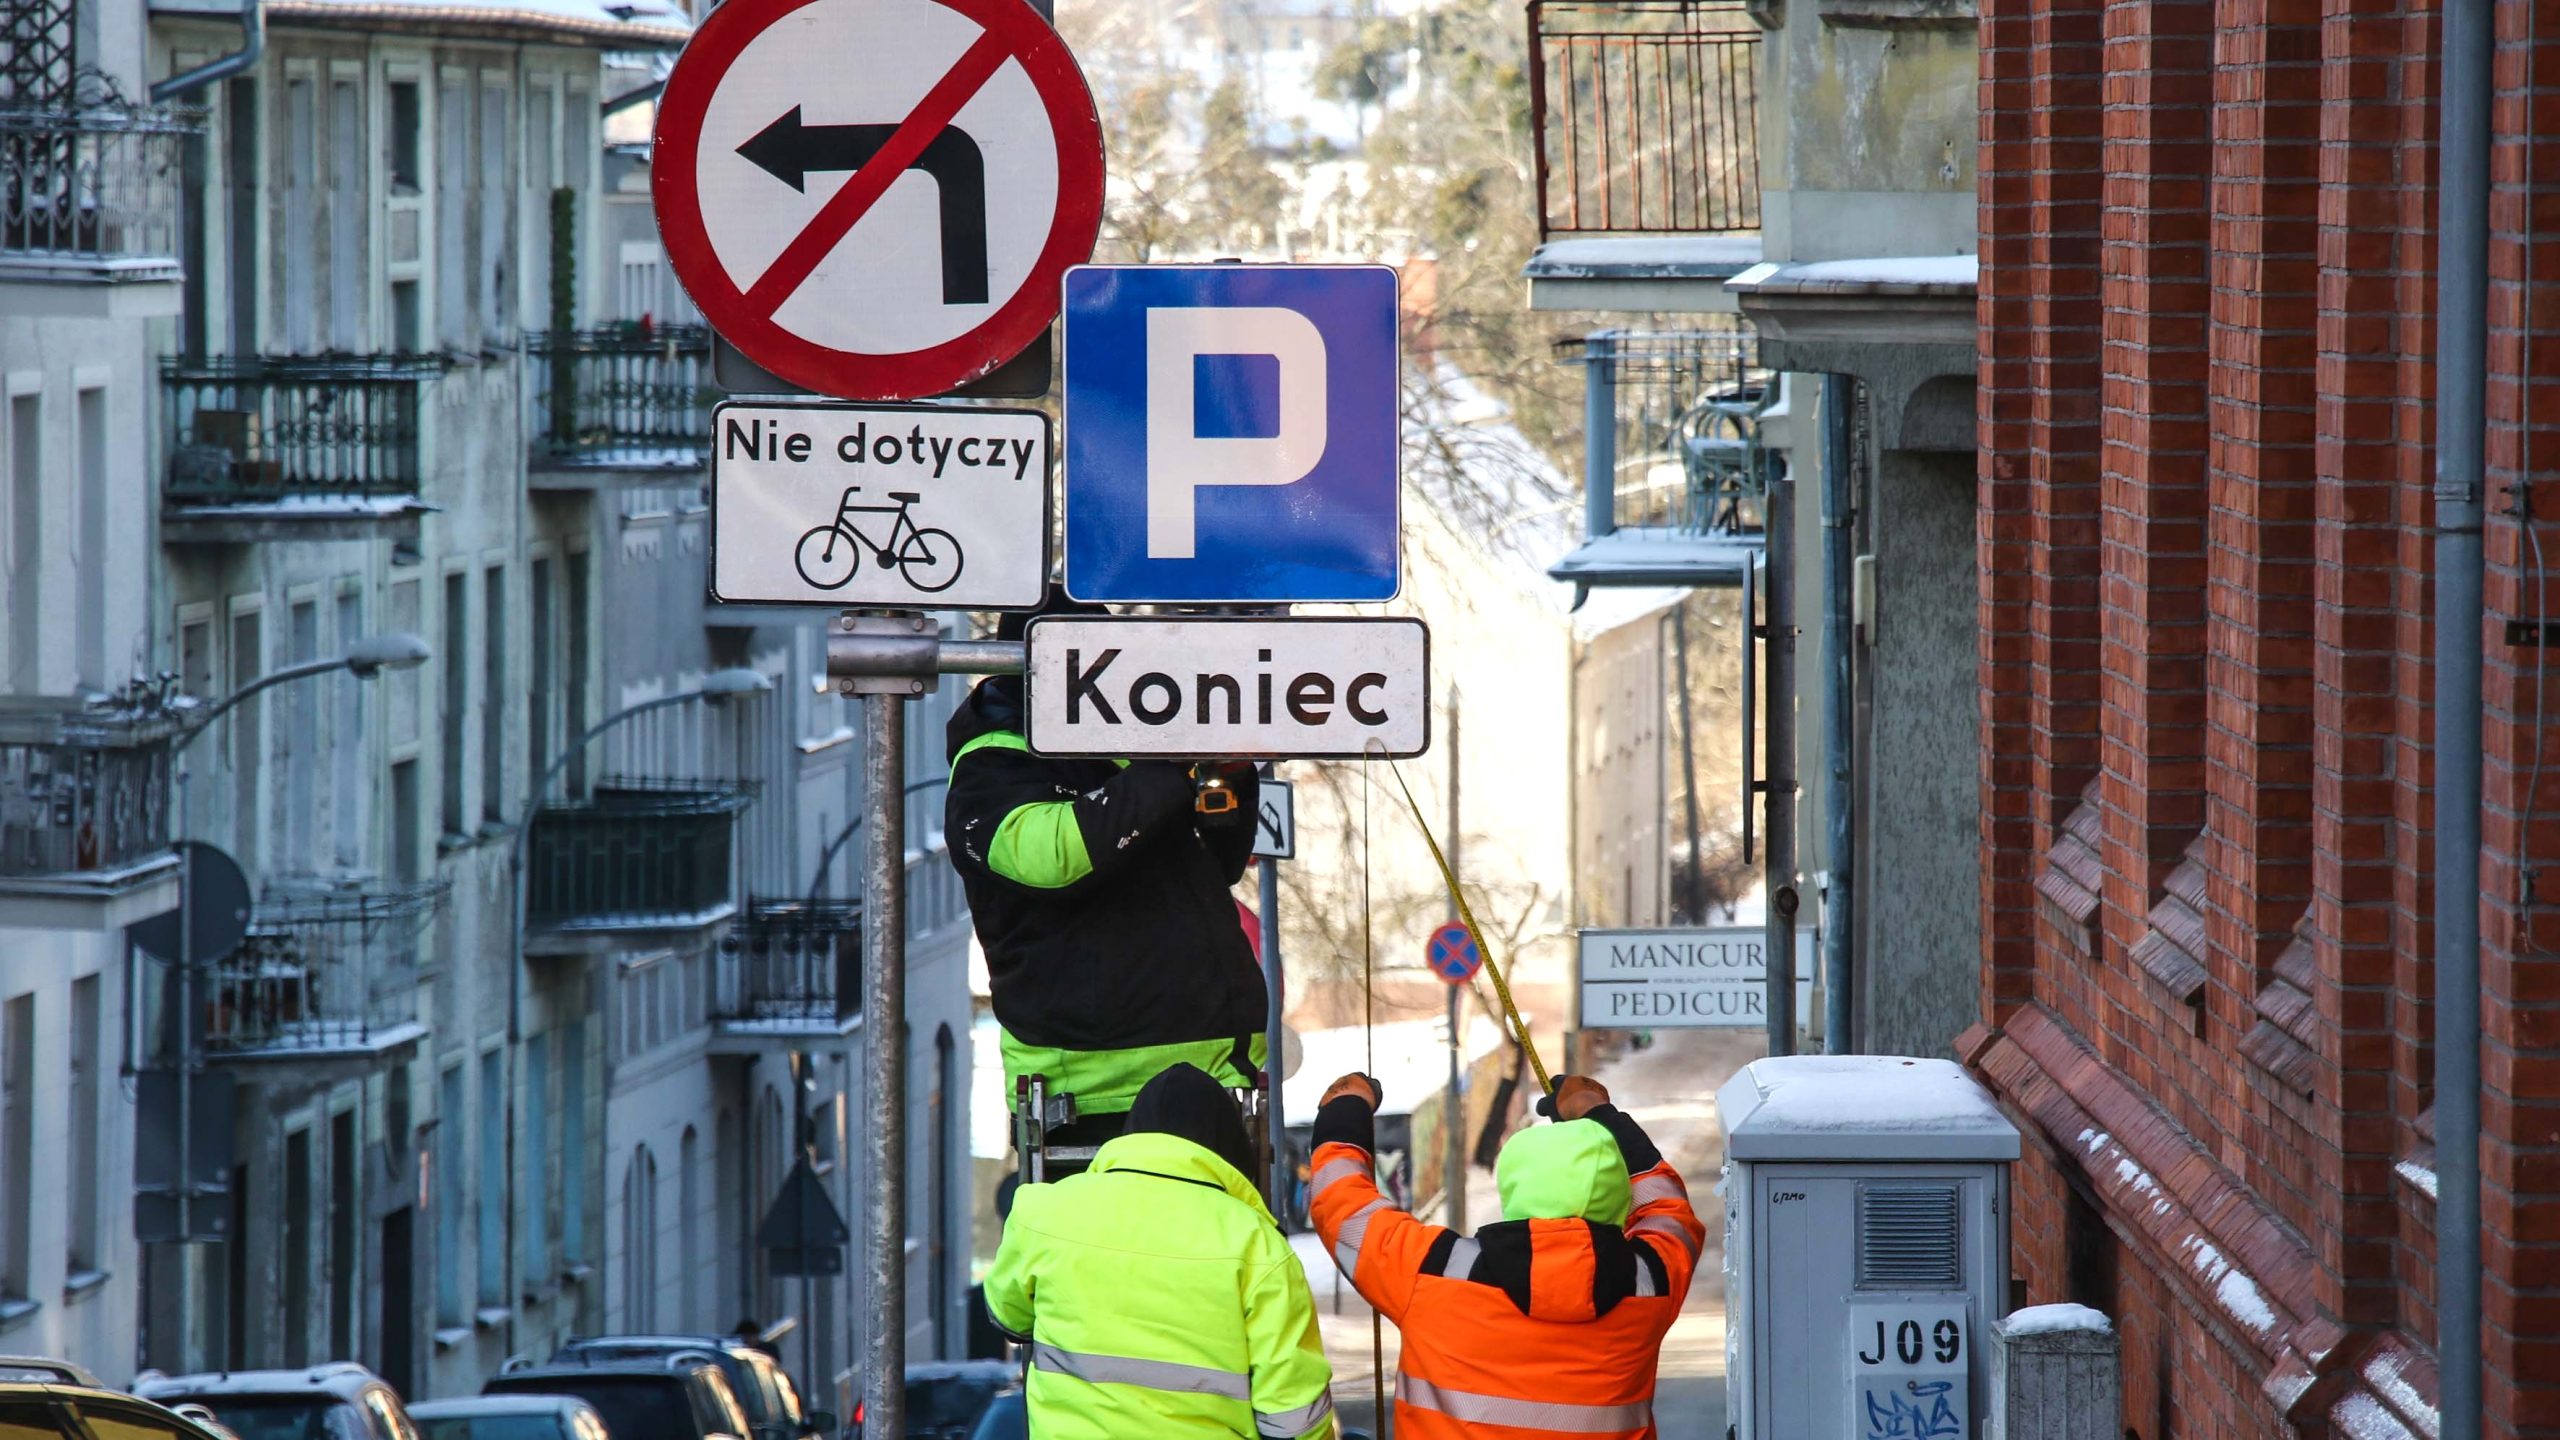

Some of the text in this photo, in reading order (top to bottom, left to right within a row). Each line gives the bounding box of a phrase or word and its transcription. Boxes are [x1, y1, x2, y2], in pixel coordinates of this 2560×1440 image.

[726, 418, 1036, 481] Nie dotyczy
[1146, 307, 1328, 560] P
[1066, 648, 1390, 727] Koniec
[1610, 943, 1766, 968] MANICUR
[1611, 991, 1764, 1016] PEDICUR
[1859, 1319, 1960, 1365] J09
